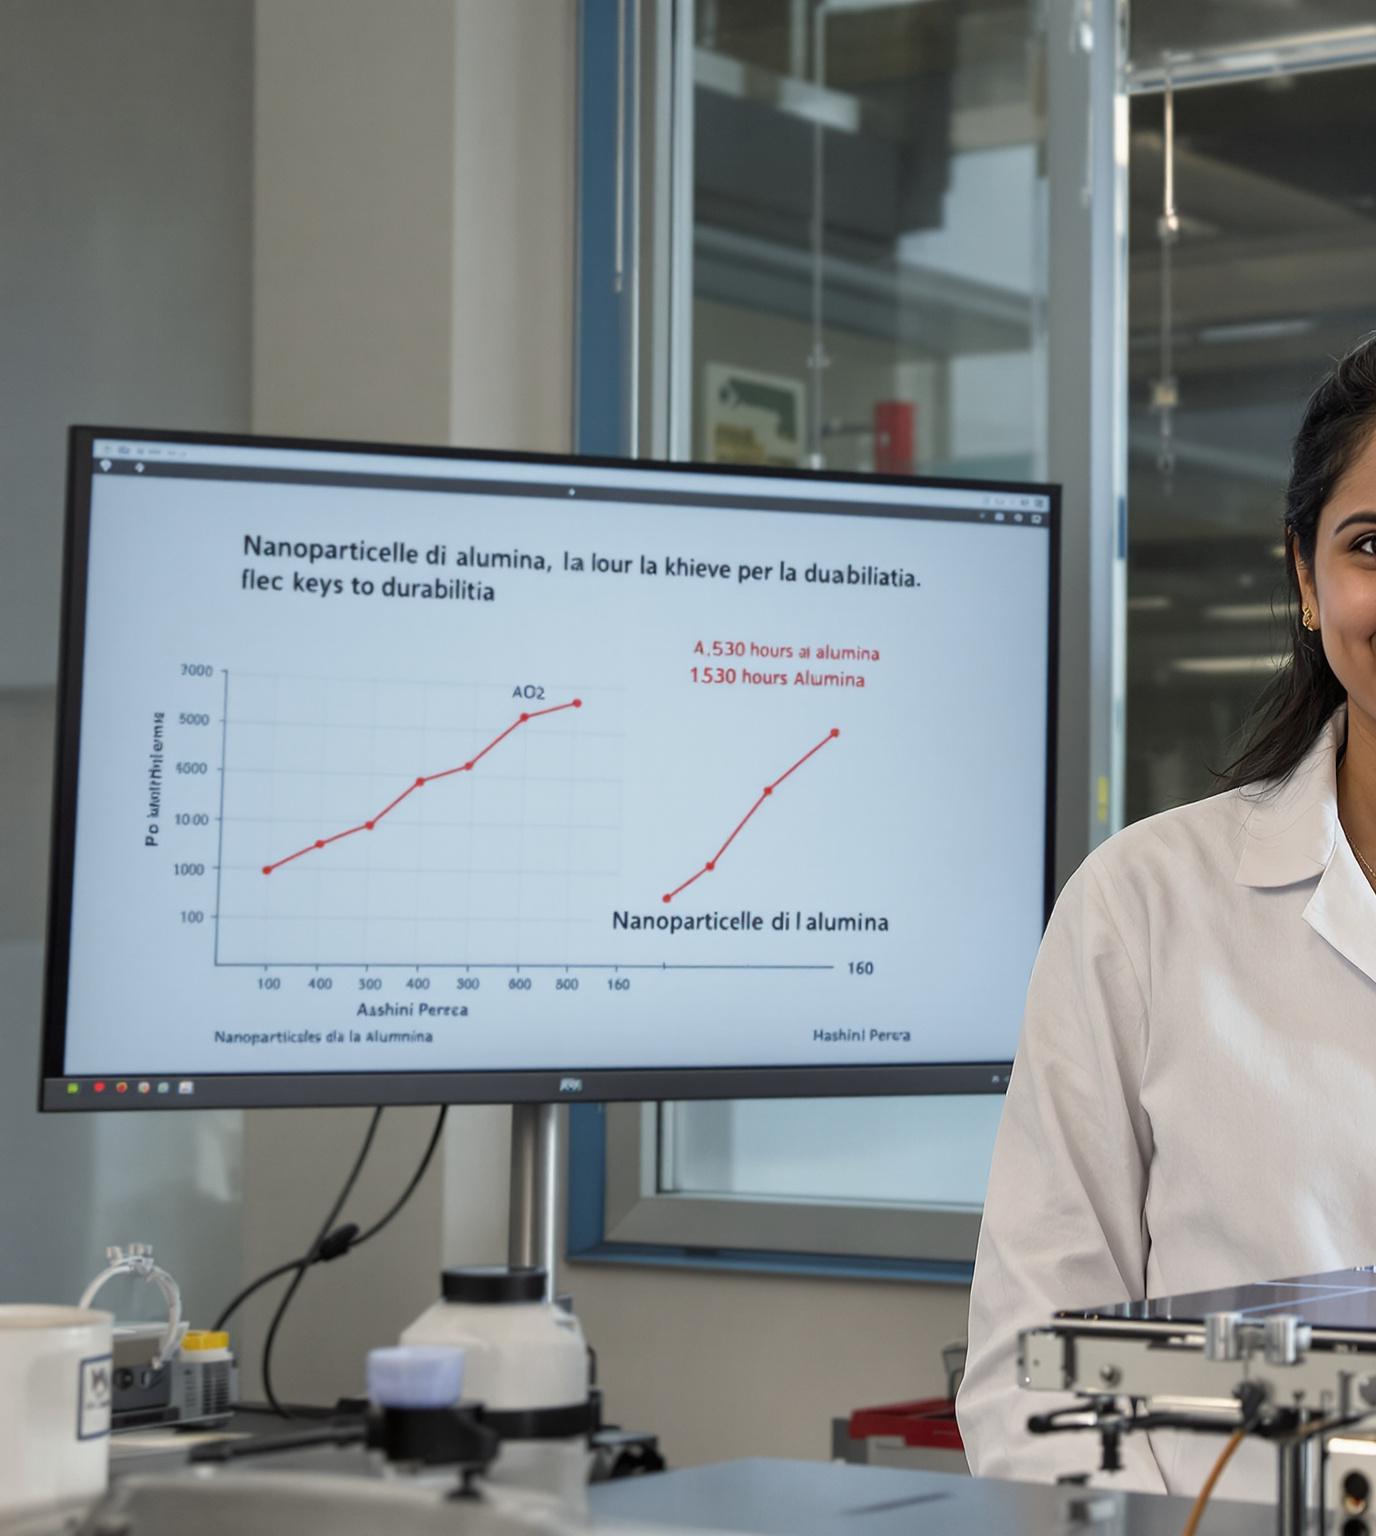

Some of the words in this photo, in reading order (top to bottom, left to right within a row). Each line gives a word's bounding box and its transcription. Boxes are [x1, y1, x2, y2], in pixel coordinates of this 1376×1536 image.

[244, 534, 418, 564] Nanoparticelle
[426, 545, 446, 565] di
[456, 546, 552, 572] alumina,
[564, 551, 584, 571] la
[641, 555, 657, 575] la
[666, 557, 731, 578] khieve
[738, 565, 773, 583] per
[780, 561, 796, 581] la
[293, 572, 343, 597] keys
[352, 578, 374, 595] to
[382, 576, 494, 601] durabilitia
[750, 642, 793, 658] hours
[816, 644, 880, 661] alumina
[742, 668, 788, 685] hours
[794, 670, 865, 688] Alumina
[175, 863, 205, 876] 1000
[181, 910, 204, 924] 100
[613, 911, 763, 934] Nanoparticelle
[772, 912, 789, 930] di
[806, 912, 888, 931] alumina
[849, 961, 874, 975] 160
[258, 978, 281, 990] 100
